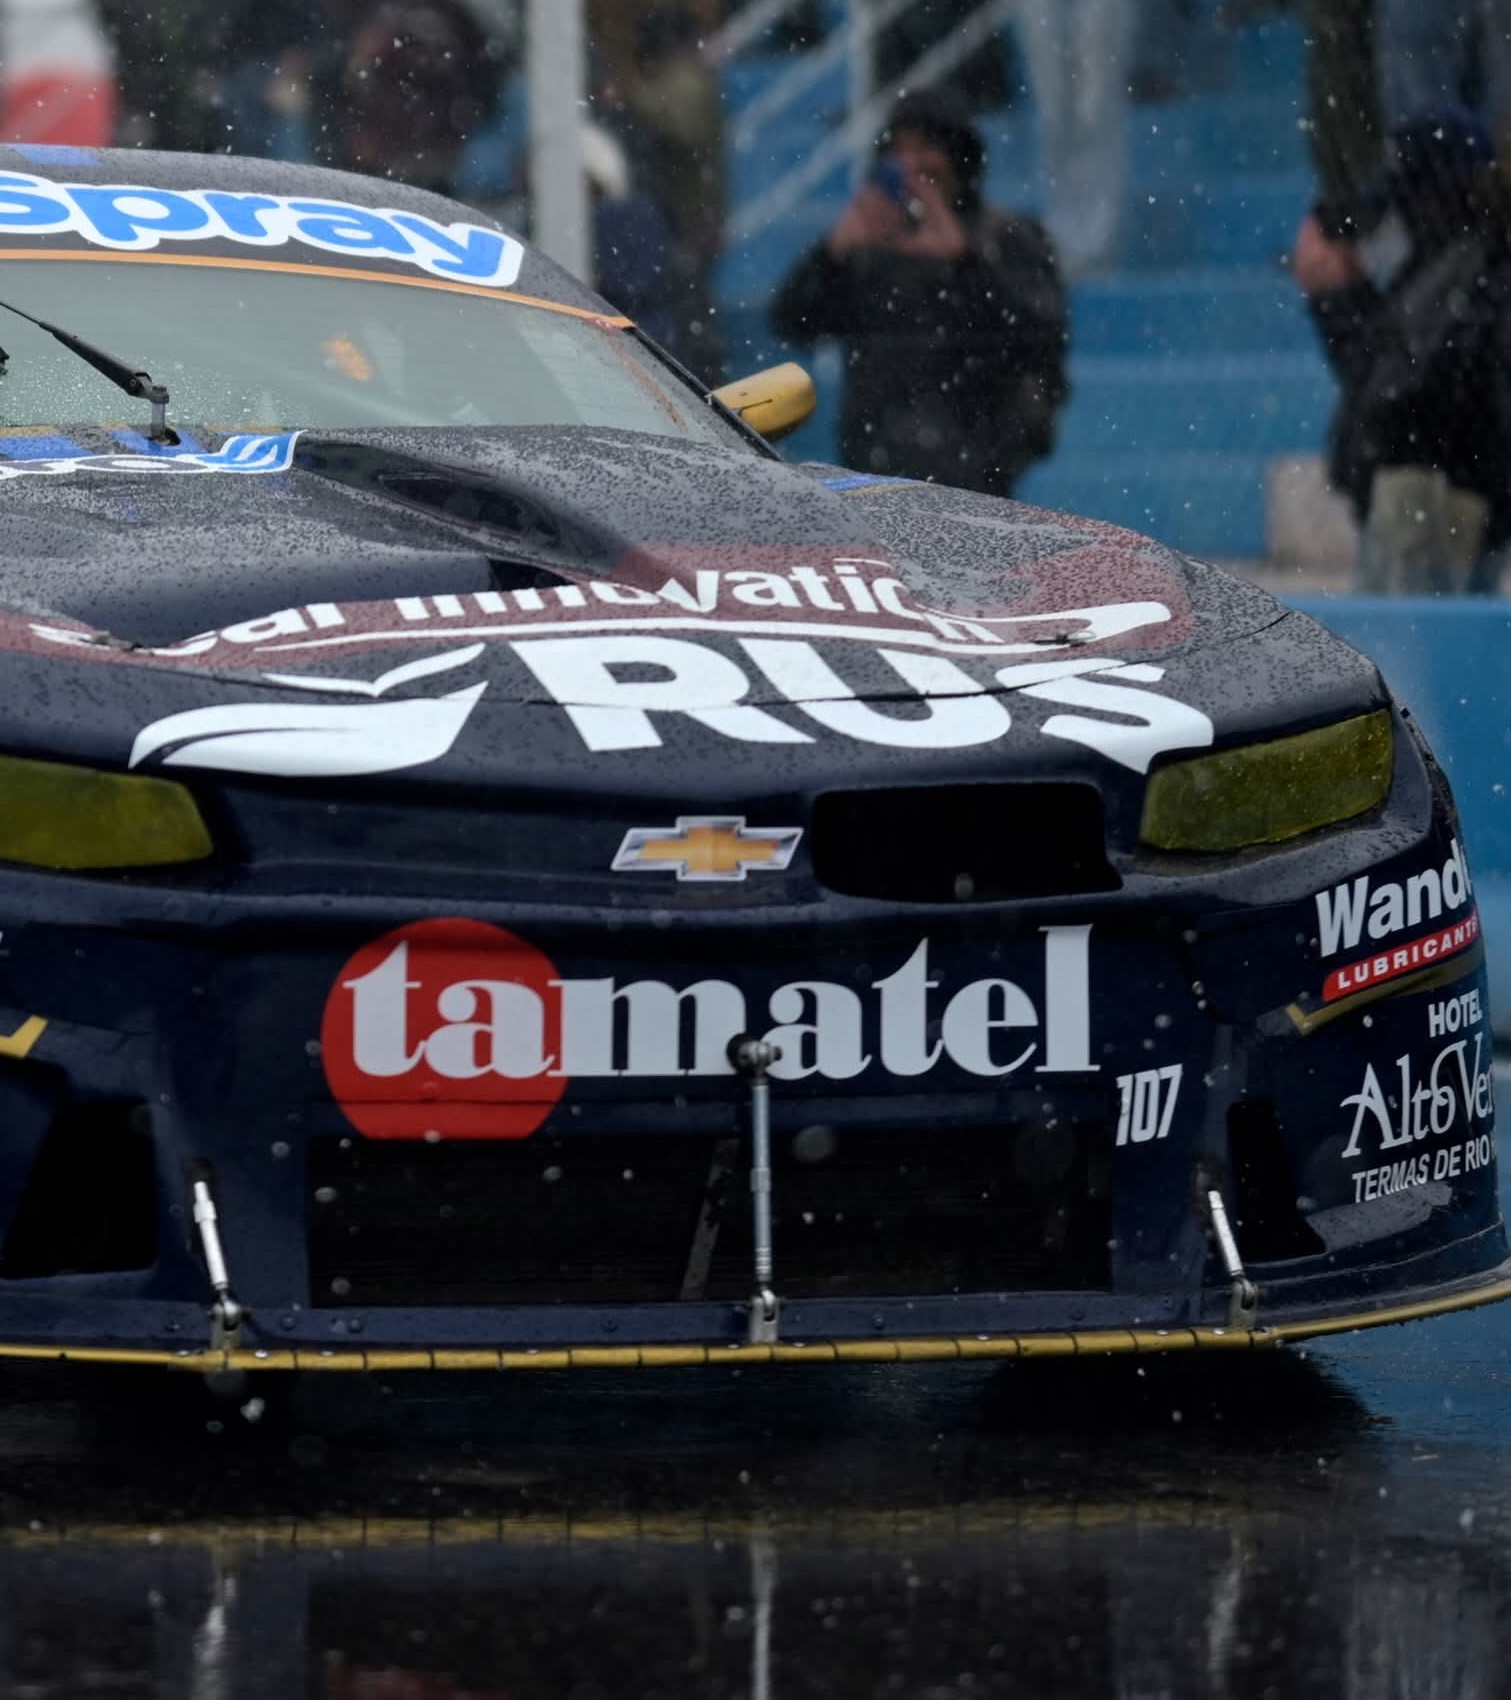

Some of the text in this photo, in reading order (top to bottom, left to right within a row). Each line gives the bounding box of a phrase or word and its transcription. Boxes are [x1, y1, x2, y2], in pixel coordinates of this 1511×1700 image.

[509, 636, 1215, 775] RUS
[342, 923, 1102, 1080] tamatel
[1115, 1063, 1183, 1147] 107
[1352, 1151, 1428, 1203] TERMAS
[1433, 1145, 1462, 1180] DE
[1465, 1134, 1490, 1172] RIO
